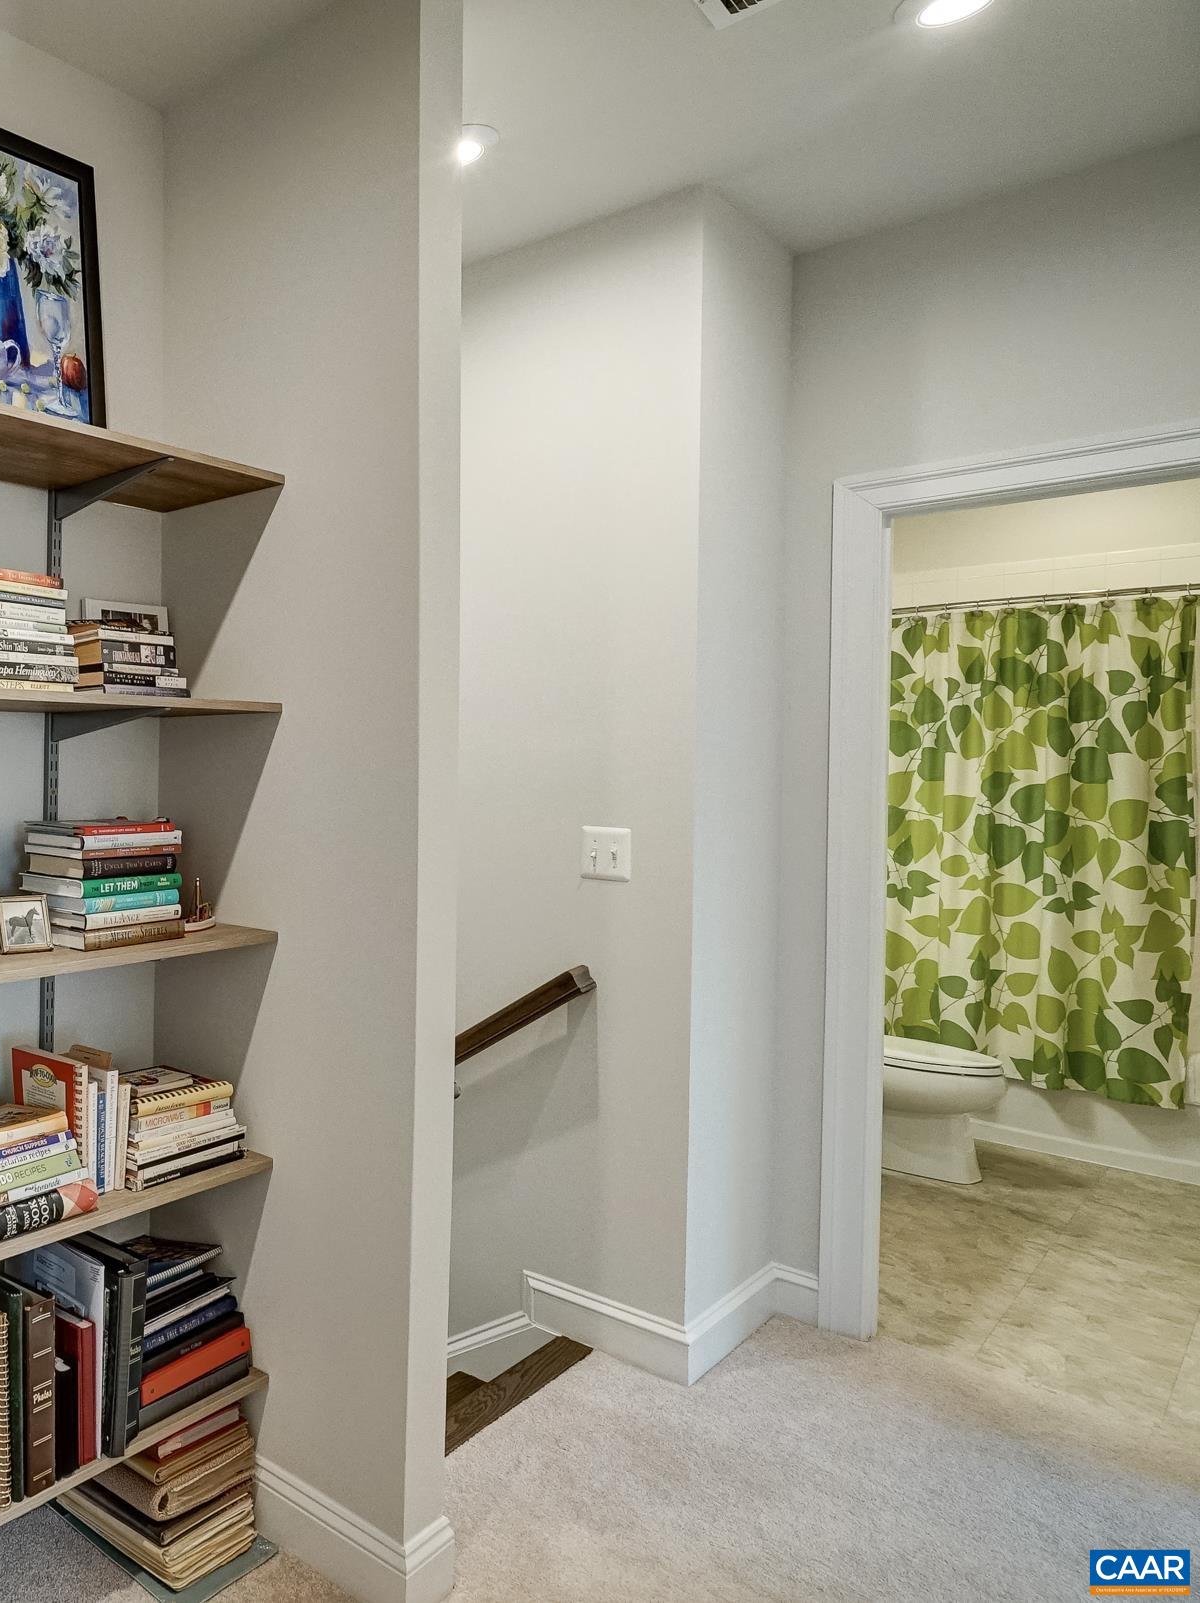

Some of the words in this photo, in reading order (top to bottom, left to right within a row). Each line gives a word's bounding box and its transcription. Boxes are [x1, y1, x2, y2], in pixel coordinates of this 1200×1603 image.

[0, 639, 13, 652] Shin
[14, 664, 60, 680] Hemingway
[104, 862, 124, 870] UNCLE
[144, 860, 162, 868] CABIN
[100, 882, 114, 893] LET
[115, 880, 138, 892] THEM
[110, 932, 132, 942] MUSIC
[140, 926, 168, 938] SPHERES
[144, 1111, 185, 1128] MICROWAVE
[2, 1144, 24, 1156] CHURCH
[24, 1138, 48, 1150] SUPPERS
[28, 1148, 52, 1159] recipes
[14, 1164, 47, 1180] RECIPES
[32, 1390, 52, 1405] Photos
